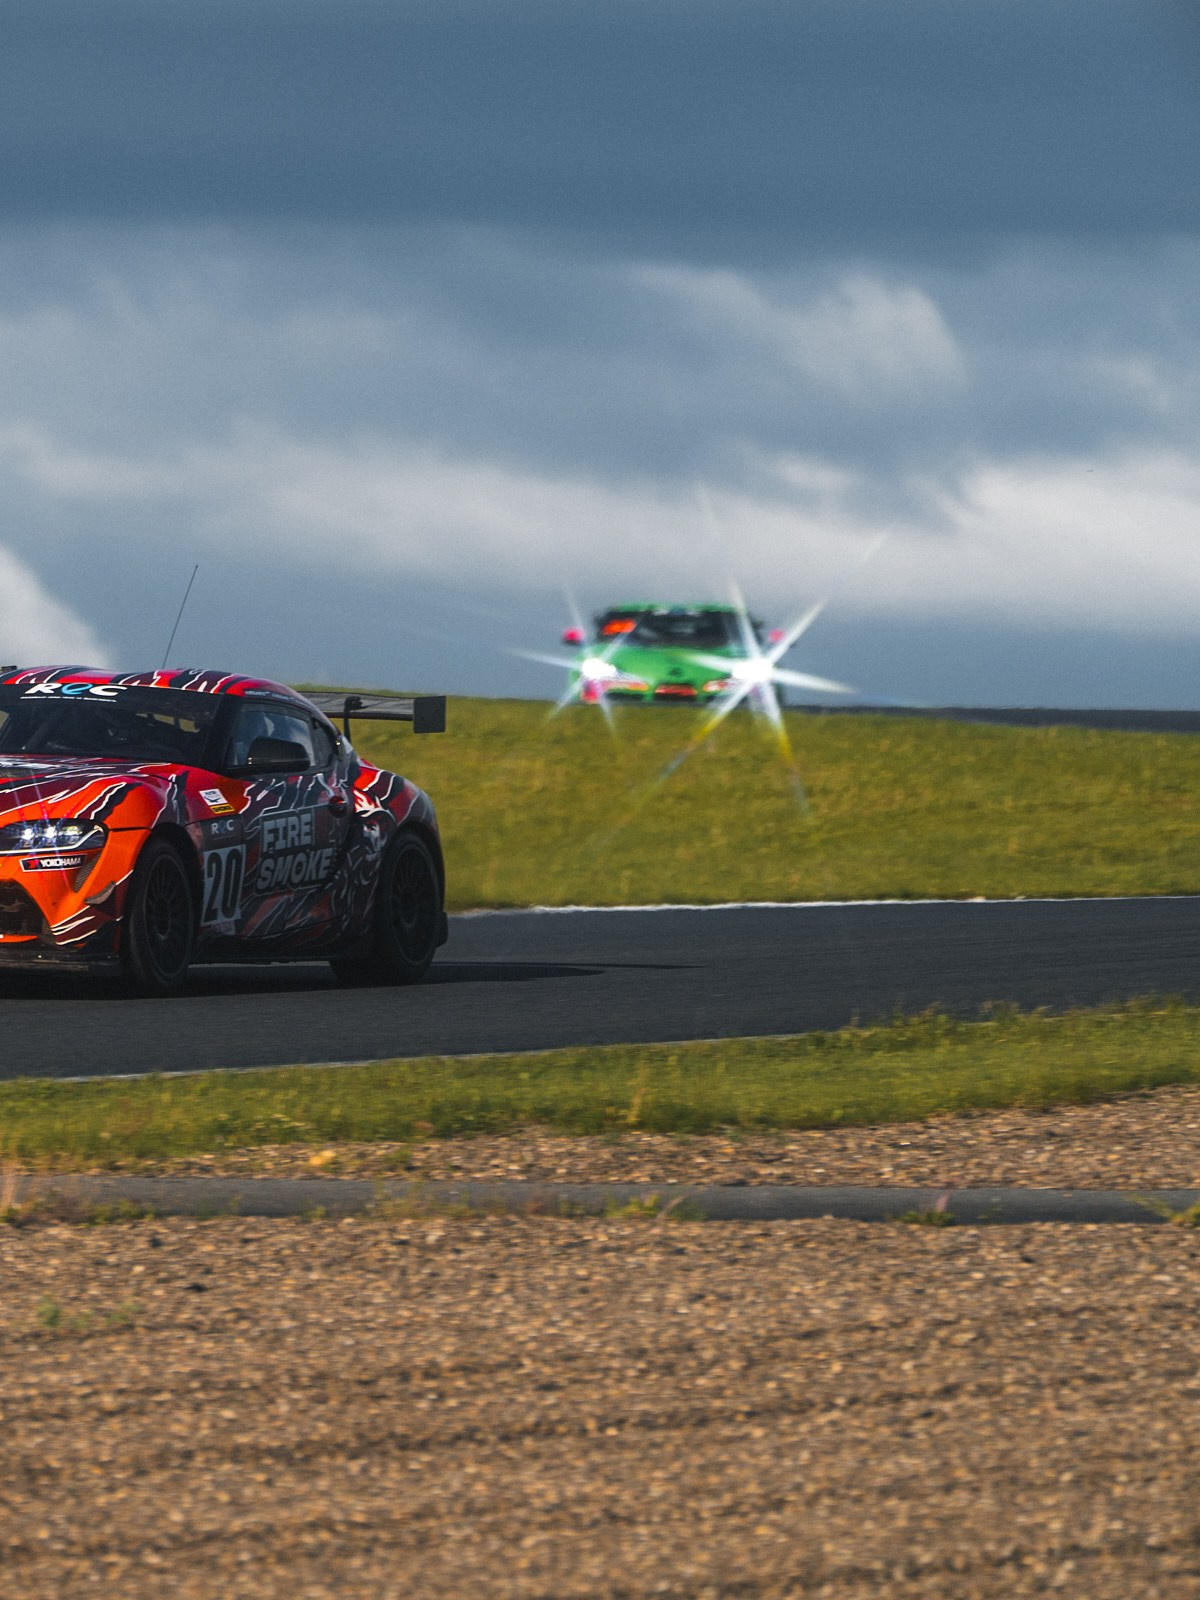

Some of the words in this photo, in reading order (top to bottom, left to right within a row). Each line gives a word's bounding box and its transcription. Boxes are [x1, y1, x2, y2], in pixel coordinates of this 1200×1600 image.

[262, 813, 313, 853] FIRE
[40, 857, 82, 868] YOKOHAMA
[256, 847, 334, 890] SMOKE
[203, 848, 243, 923] 20
